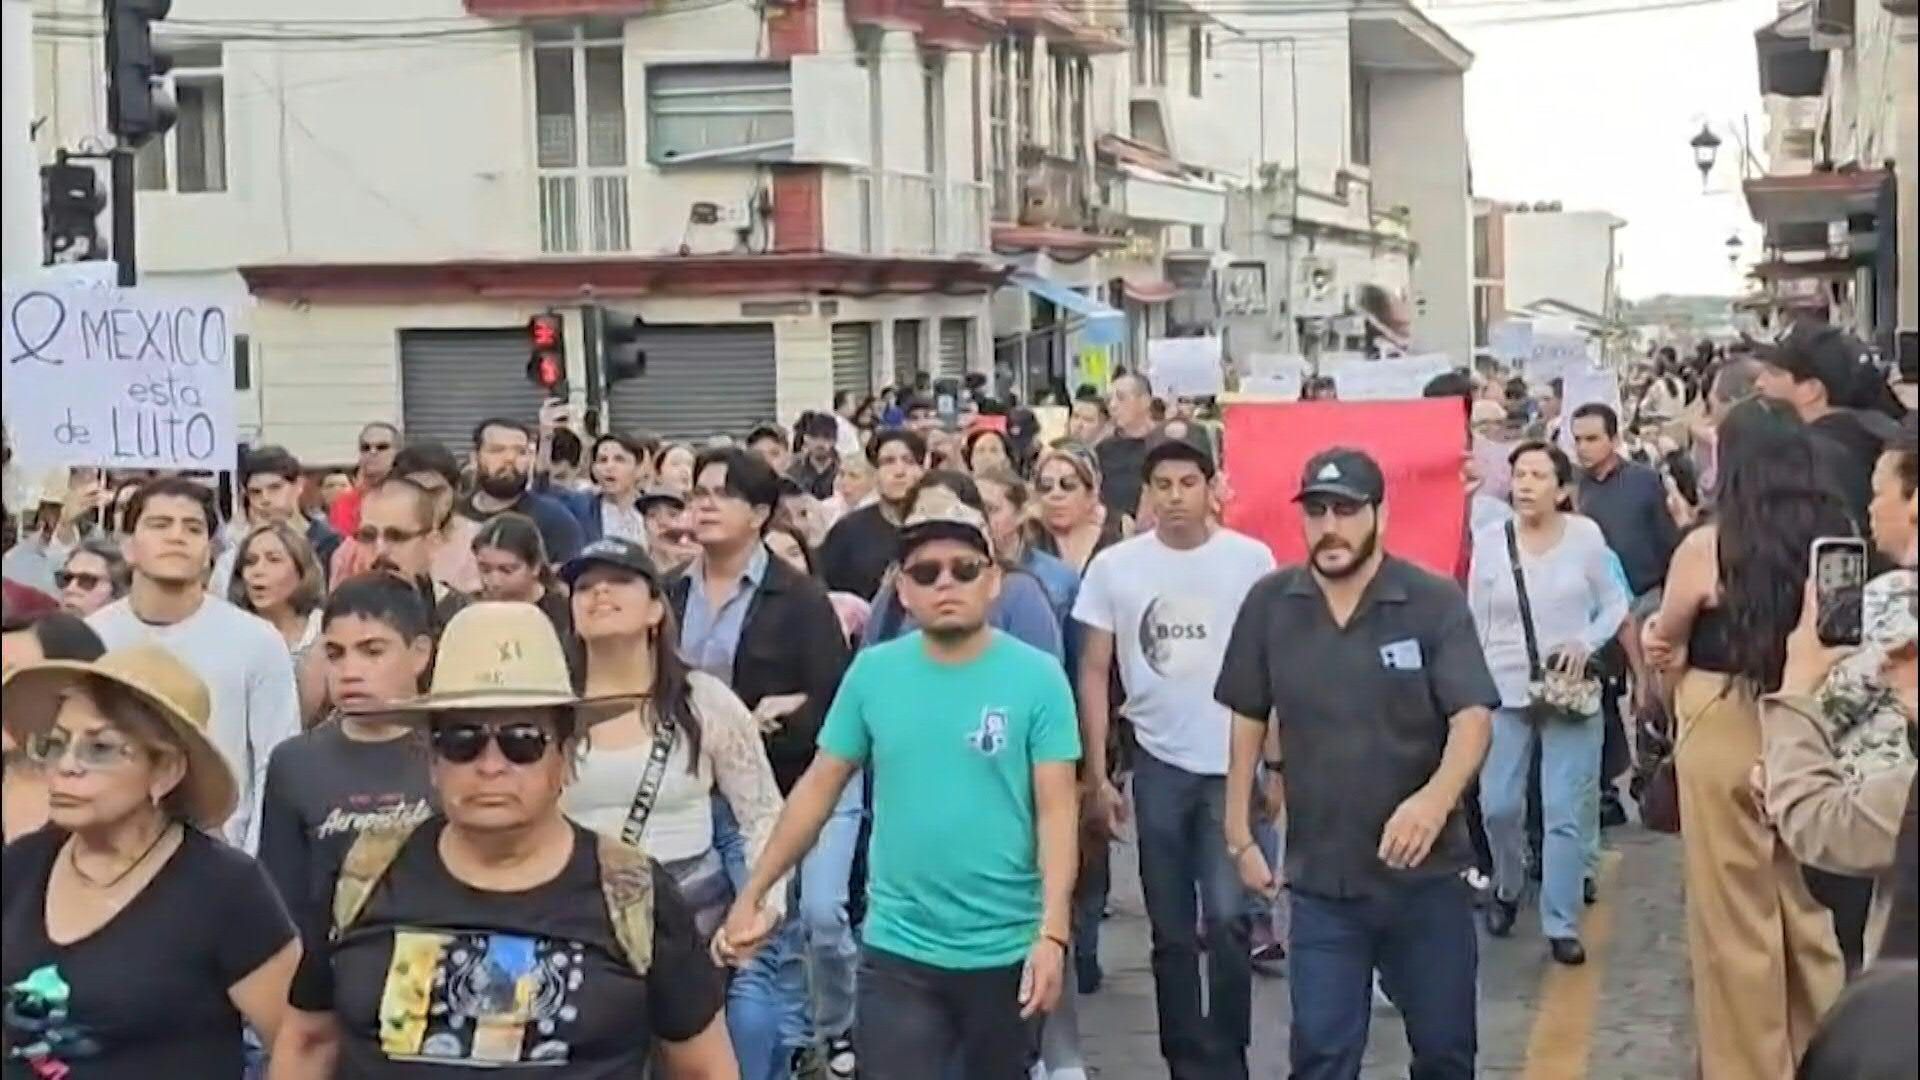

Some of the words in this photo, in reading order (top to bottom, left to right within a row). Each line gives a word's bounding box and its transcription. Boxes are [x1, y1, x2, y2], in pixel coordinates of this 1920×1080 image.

[128, 369, 202, 408] esta
[54, 407, 91, 444] de
[112, 405, 215, 463] LUTO
[1156, 624, 1207, 640] BOSS
